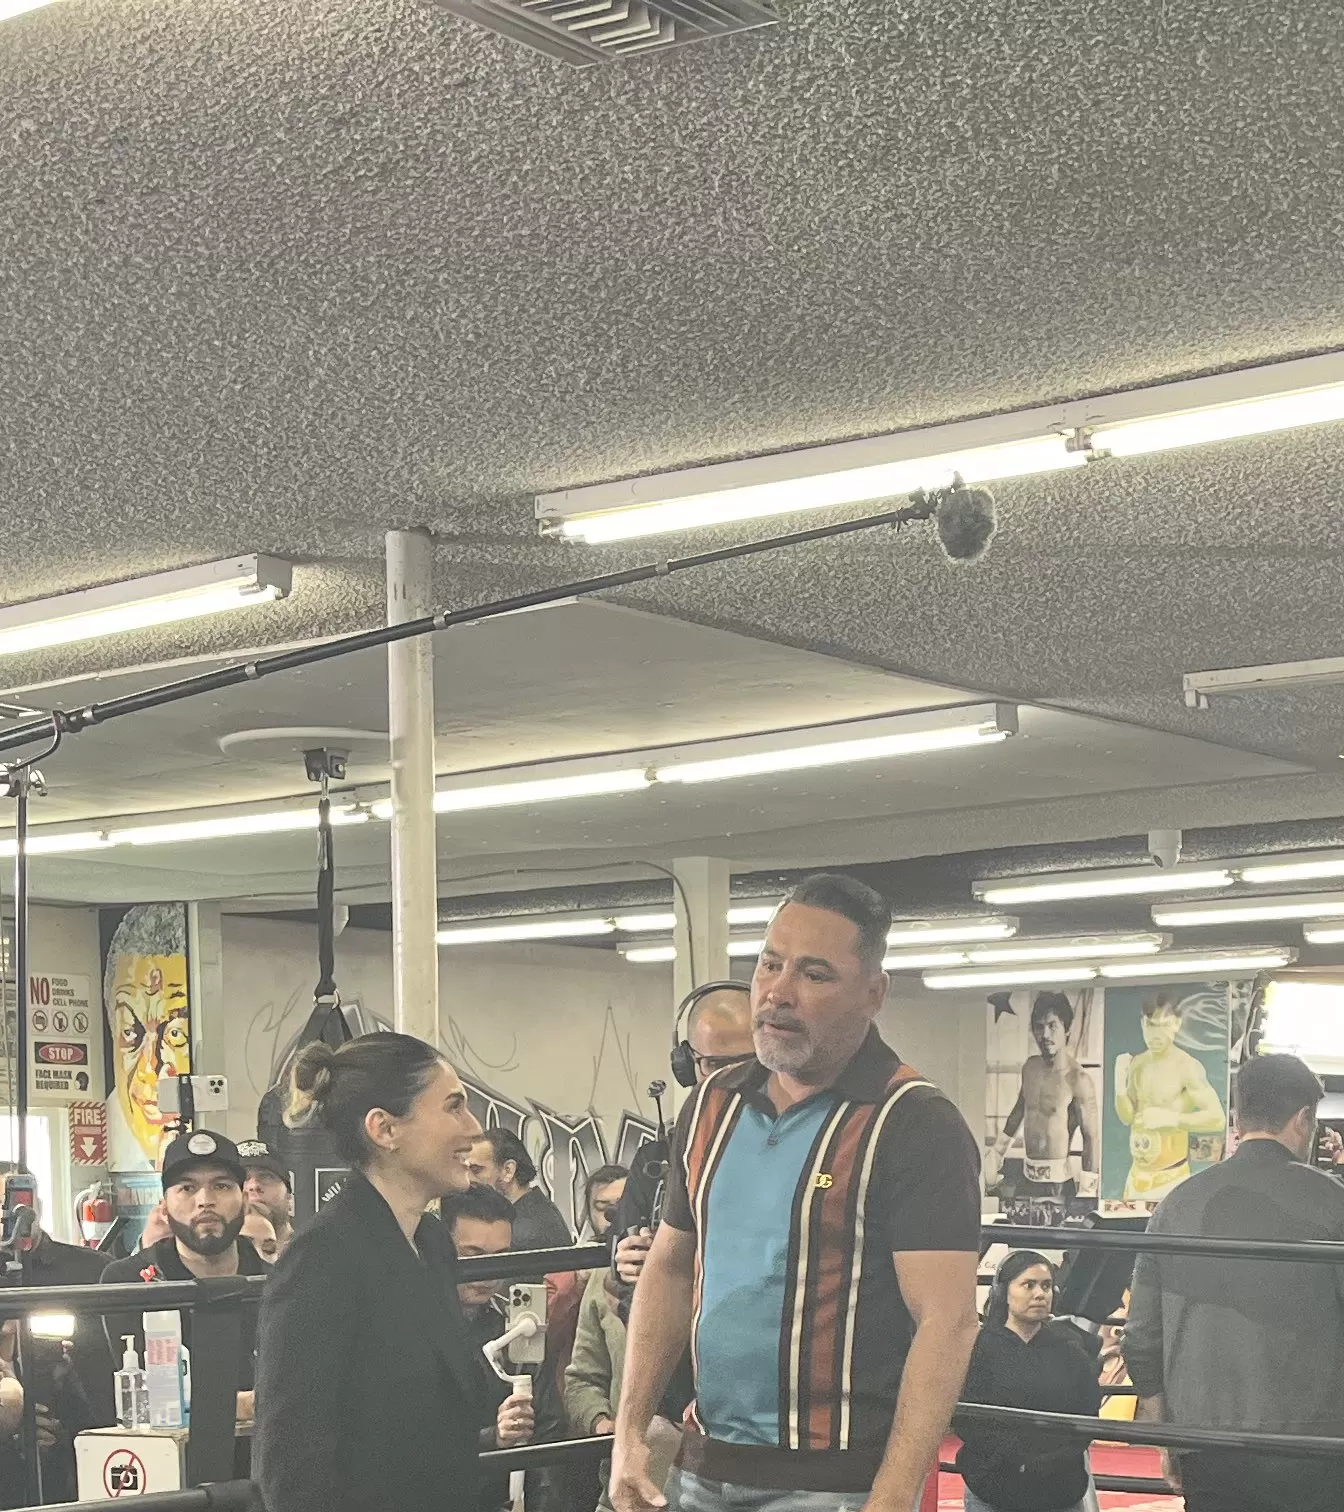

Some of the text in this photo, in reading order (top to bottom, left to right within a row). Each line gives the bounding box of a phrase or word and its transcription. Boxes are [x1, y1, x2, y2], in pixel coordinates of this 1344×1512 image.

[30, 976, 50, 1005] NO
[52, 988, 75, 996] DRINKS
[52, 998, 89, 1008] CELL PHONE
[48, 1047, 74, 1060] STOP
[35, 1069, 73, 1080] FACE MASK
[35, 1080, 69, 1091] REQUIRED
[74, 1108, 102, 1125] FIRE
